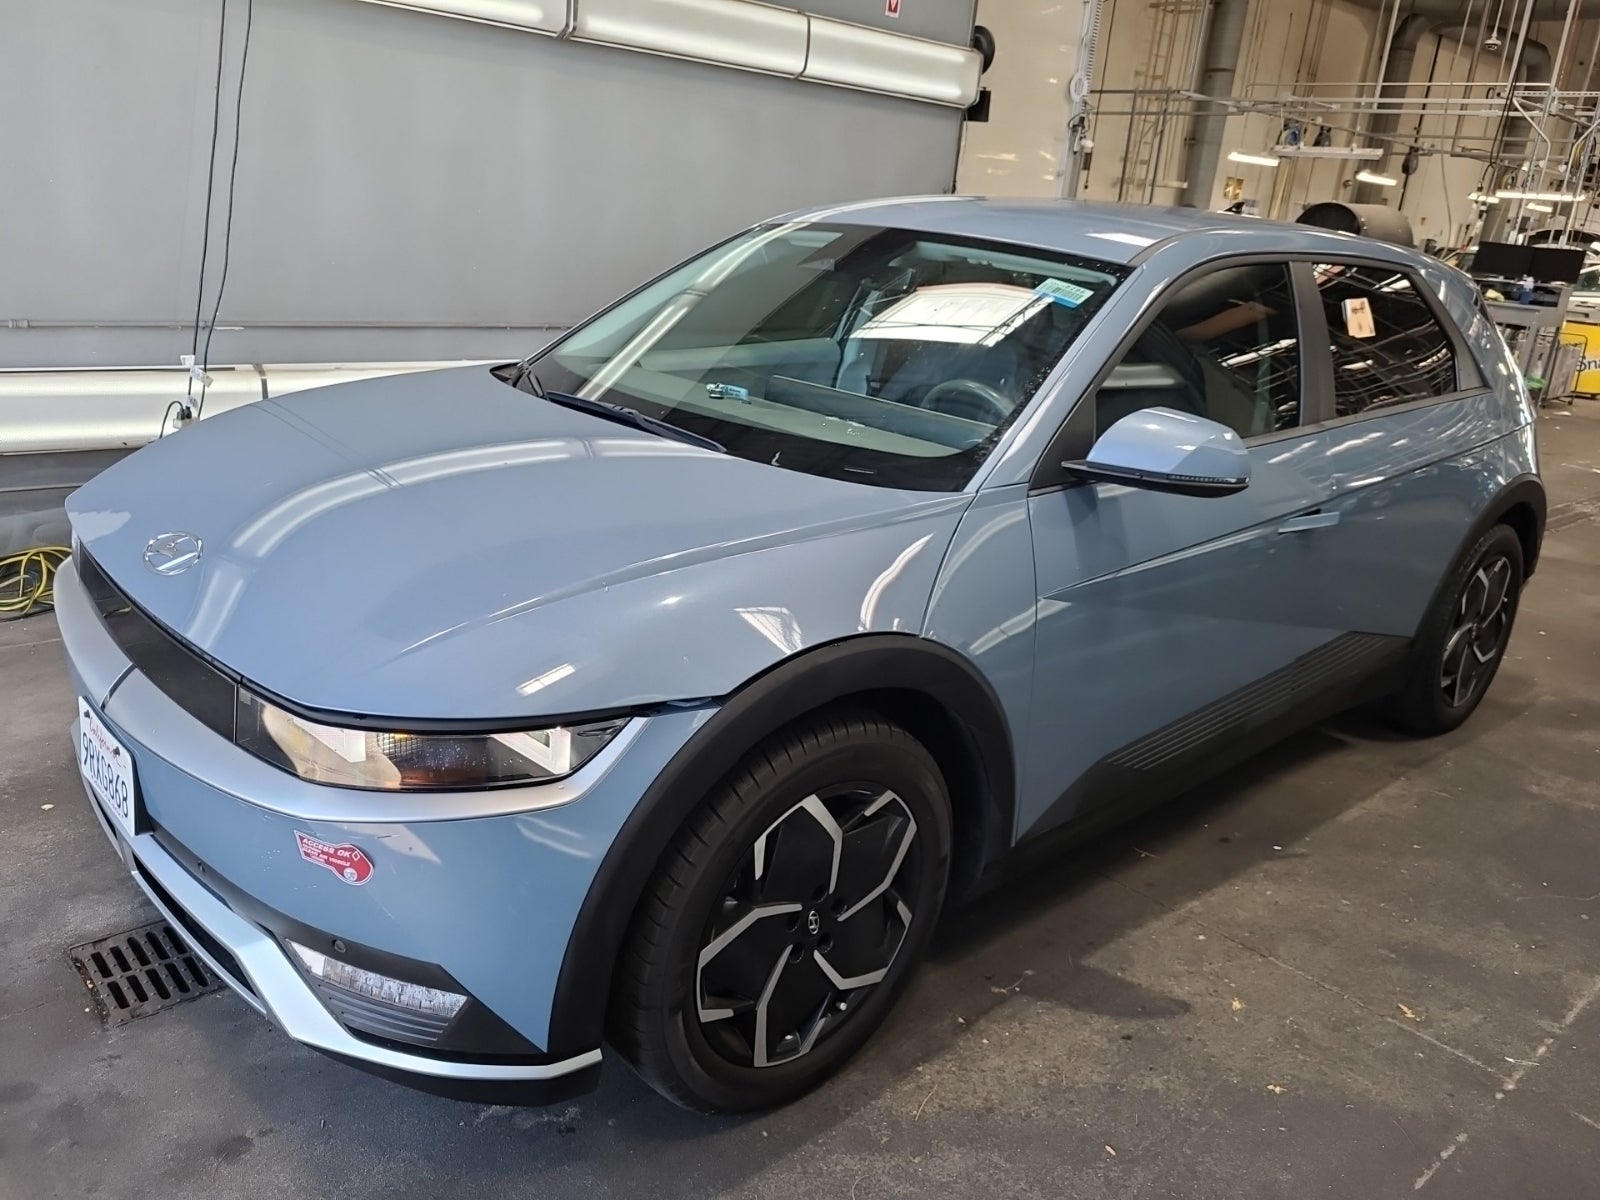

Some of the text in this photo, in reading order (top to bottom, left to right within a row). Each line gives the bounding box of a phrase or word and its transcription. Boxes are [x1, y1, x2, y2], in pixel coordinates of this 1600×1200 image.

[1576, 355, 1600, 372] Sn
[82, 731, 129, 819] 9RXG868
[302, 838, 336, 854] ACCESS
[337, 849, 352, 858] OK
